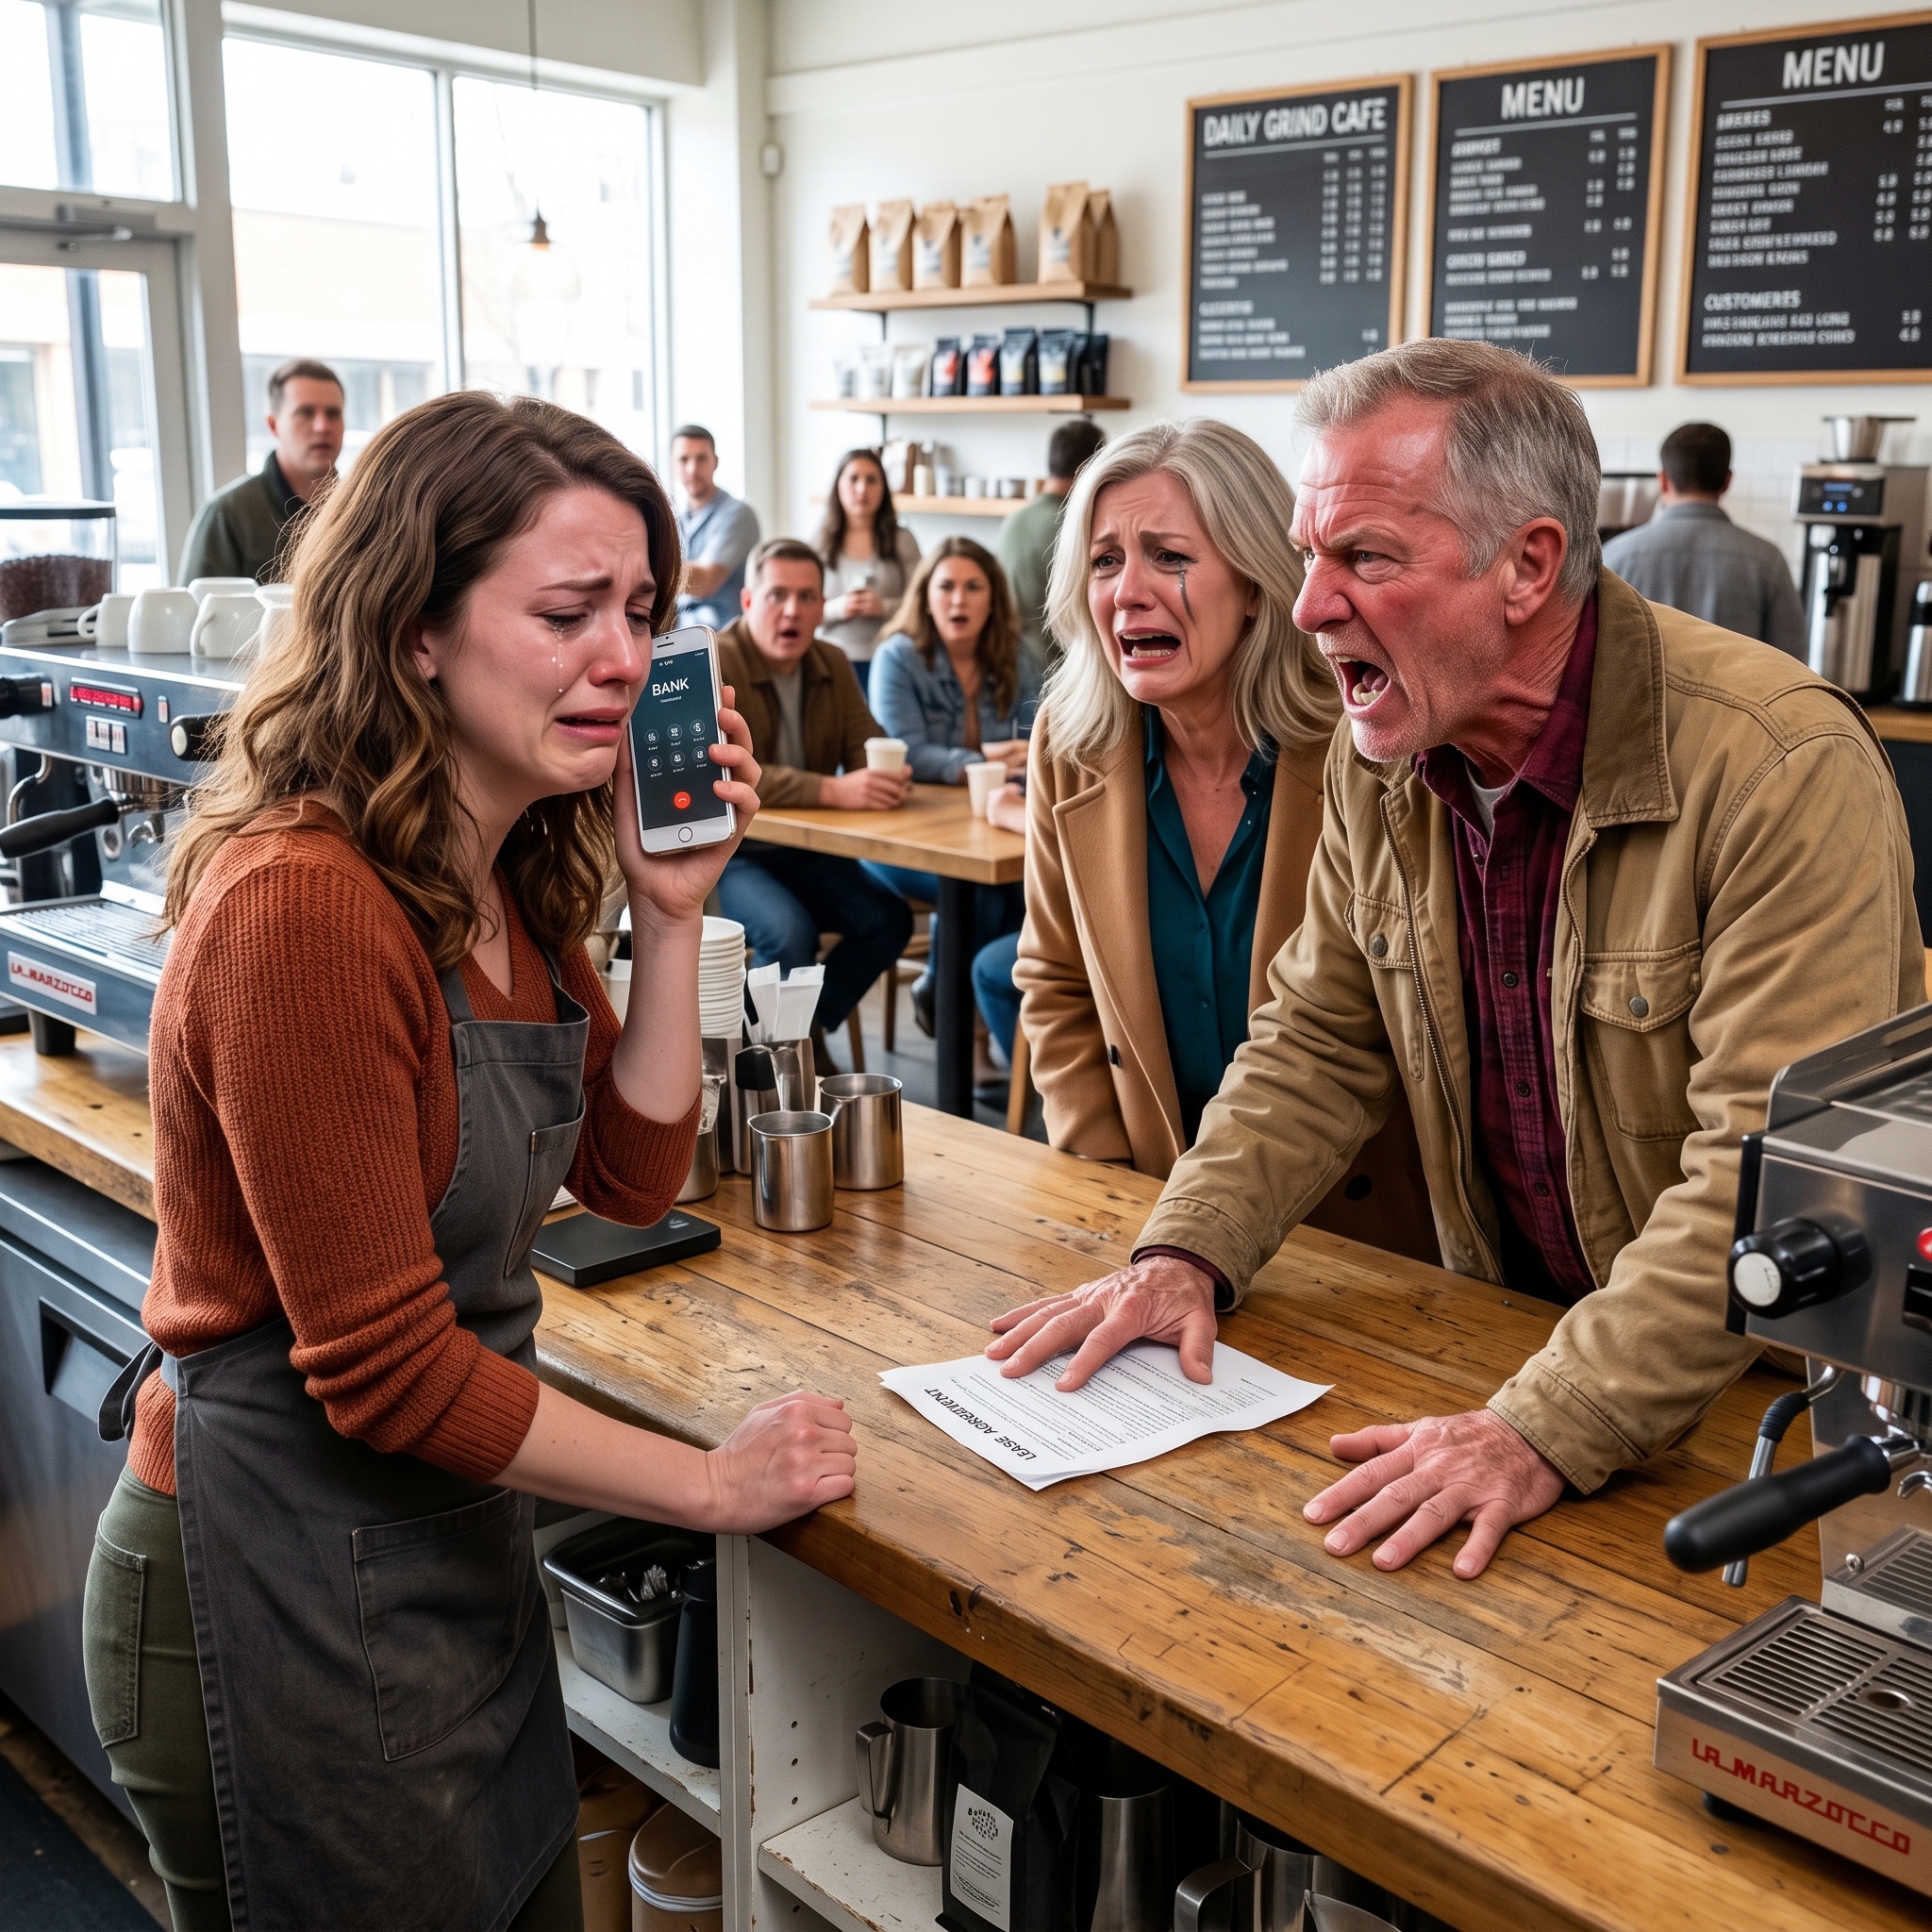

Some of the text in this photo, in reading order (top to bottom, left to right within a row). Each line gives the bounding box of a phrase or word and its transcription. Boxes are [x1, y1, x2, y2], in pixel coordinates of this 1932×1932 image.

[1782, 41, 1885, 90] MENU
[1501, 75, 1585, 120] MENU
[1203, 97, 1388, 148] DAILY GRIND CAFE
[652, 677, 690, 696] BANK
[994, 1435, 1037, 1460] LEASE
[1691, 1738, 1722, 1769] LA
